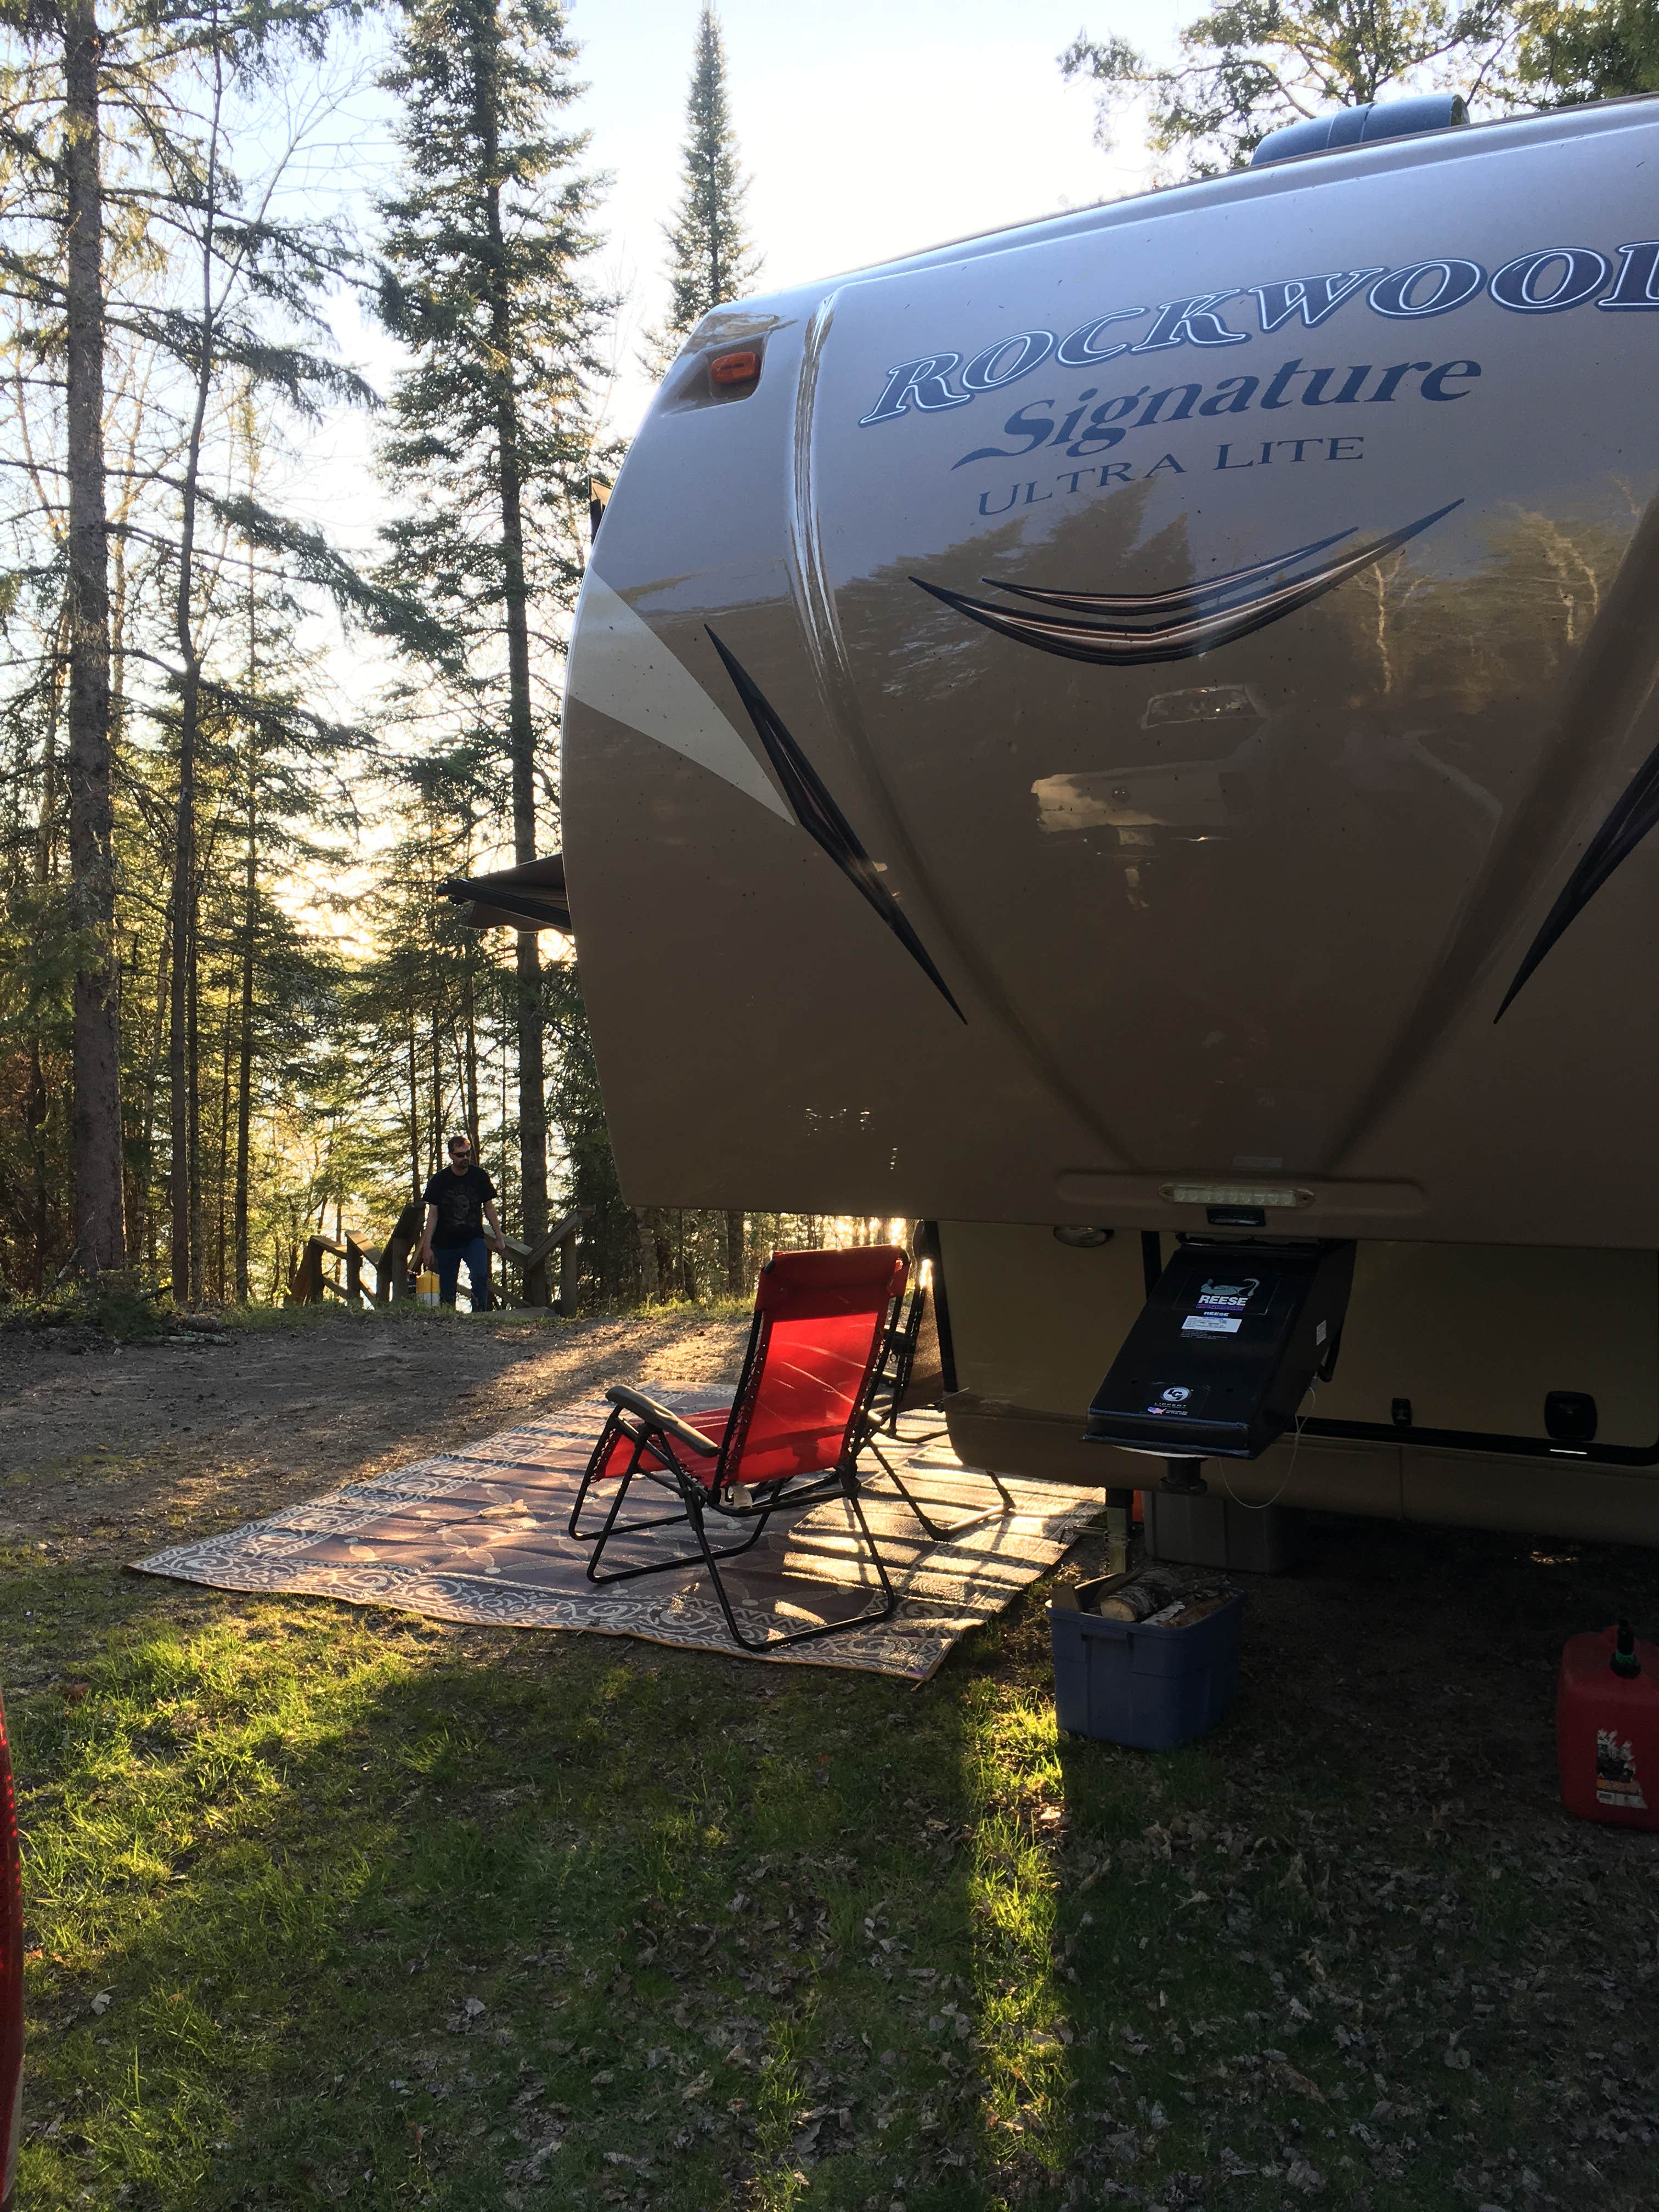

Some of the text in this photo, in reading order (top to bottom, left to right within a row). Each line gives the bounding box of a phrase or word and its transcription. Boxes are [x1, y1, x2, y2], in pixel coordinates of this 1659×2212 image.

[950, 358, 1482, 471] Signature
[978, 437, 1364, 516] ULTRA LITE
[1198, 1295, 1248, 1306] REESE
